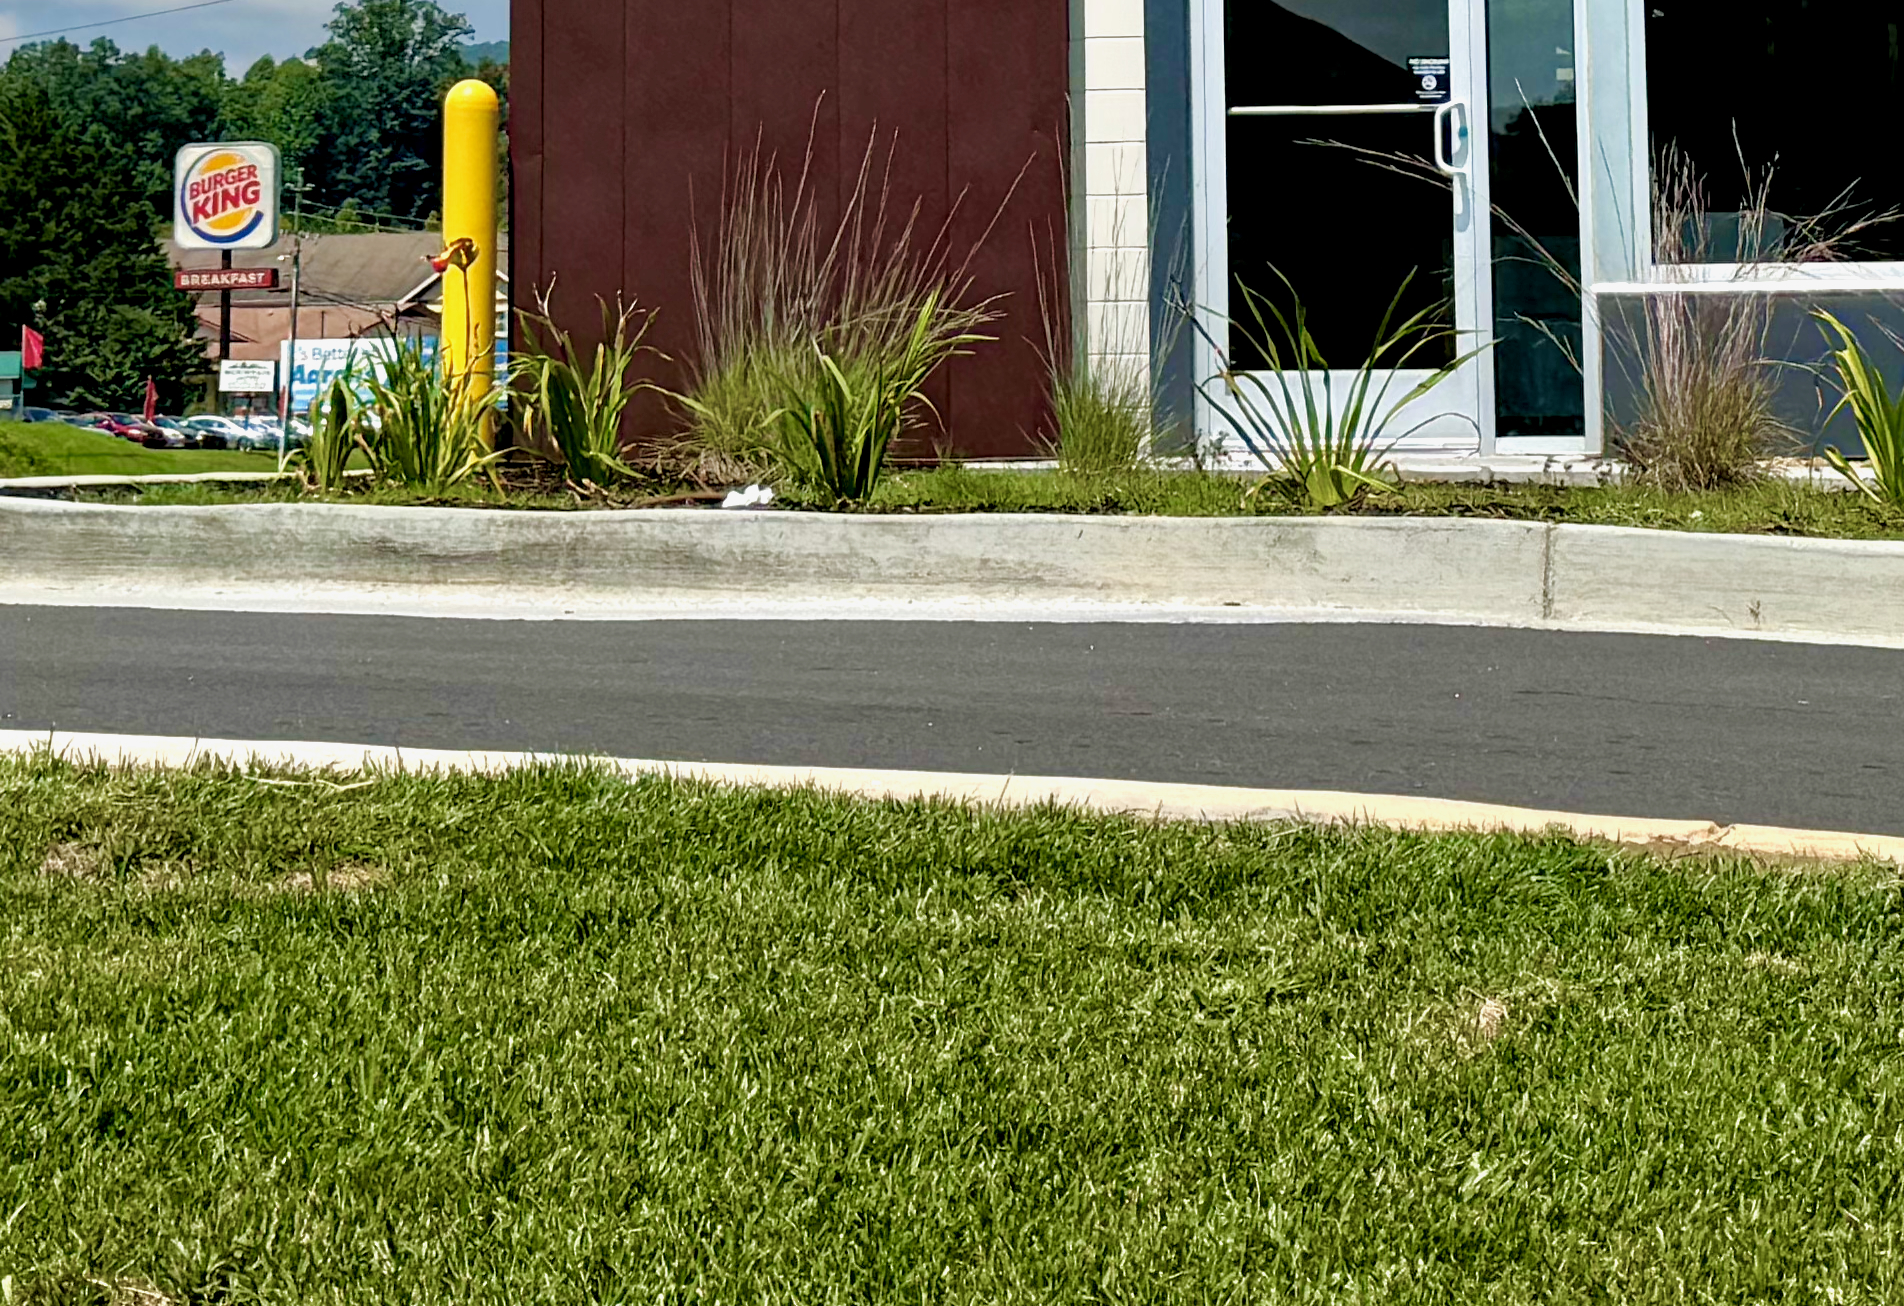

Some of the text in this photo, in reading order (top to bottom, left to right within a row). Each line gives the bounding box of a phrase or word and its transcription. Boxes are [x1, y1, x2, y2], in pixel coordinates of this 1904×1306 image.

[189, 164, 258, 201] BURGER
[192, 180, 261, 225] KING
[180, 272, 266, 287] BREAKFAST
